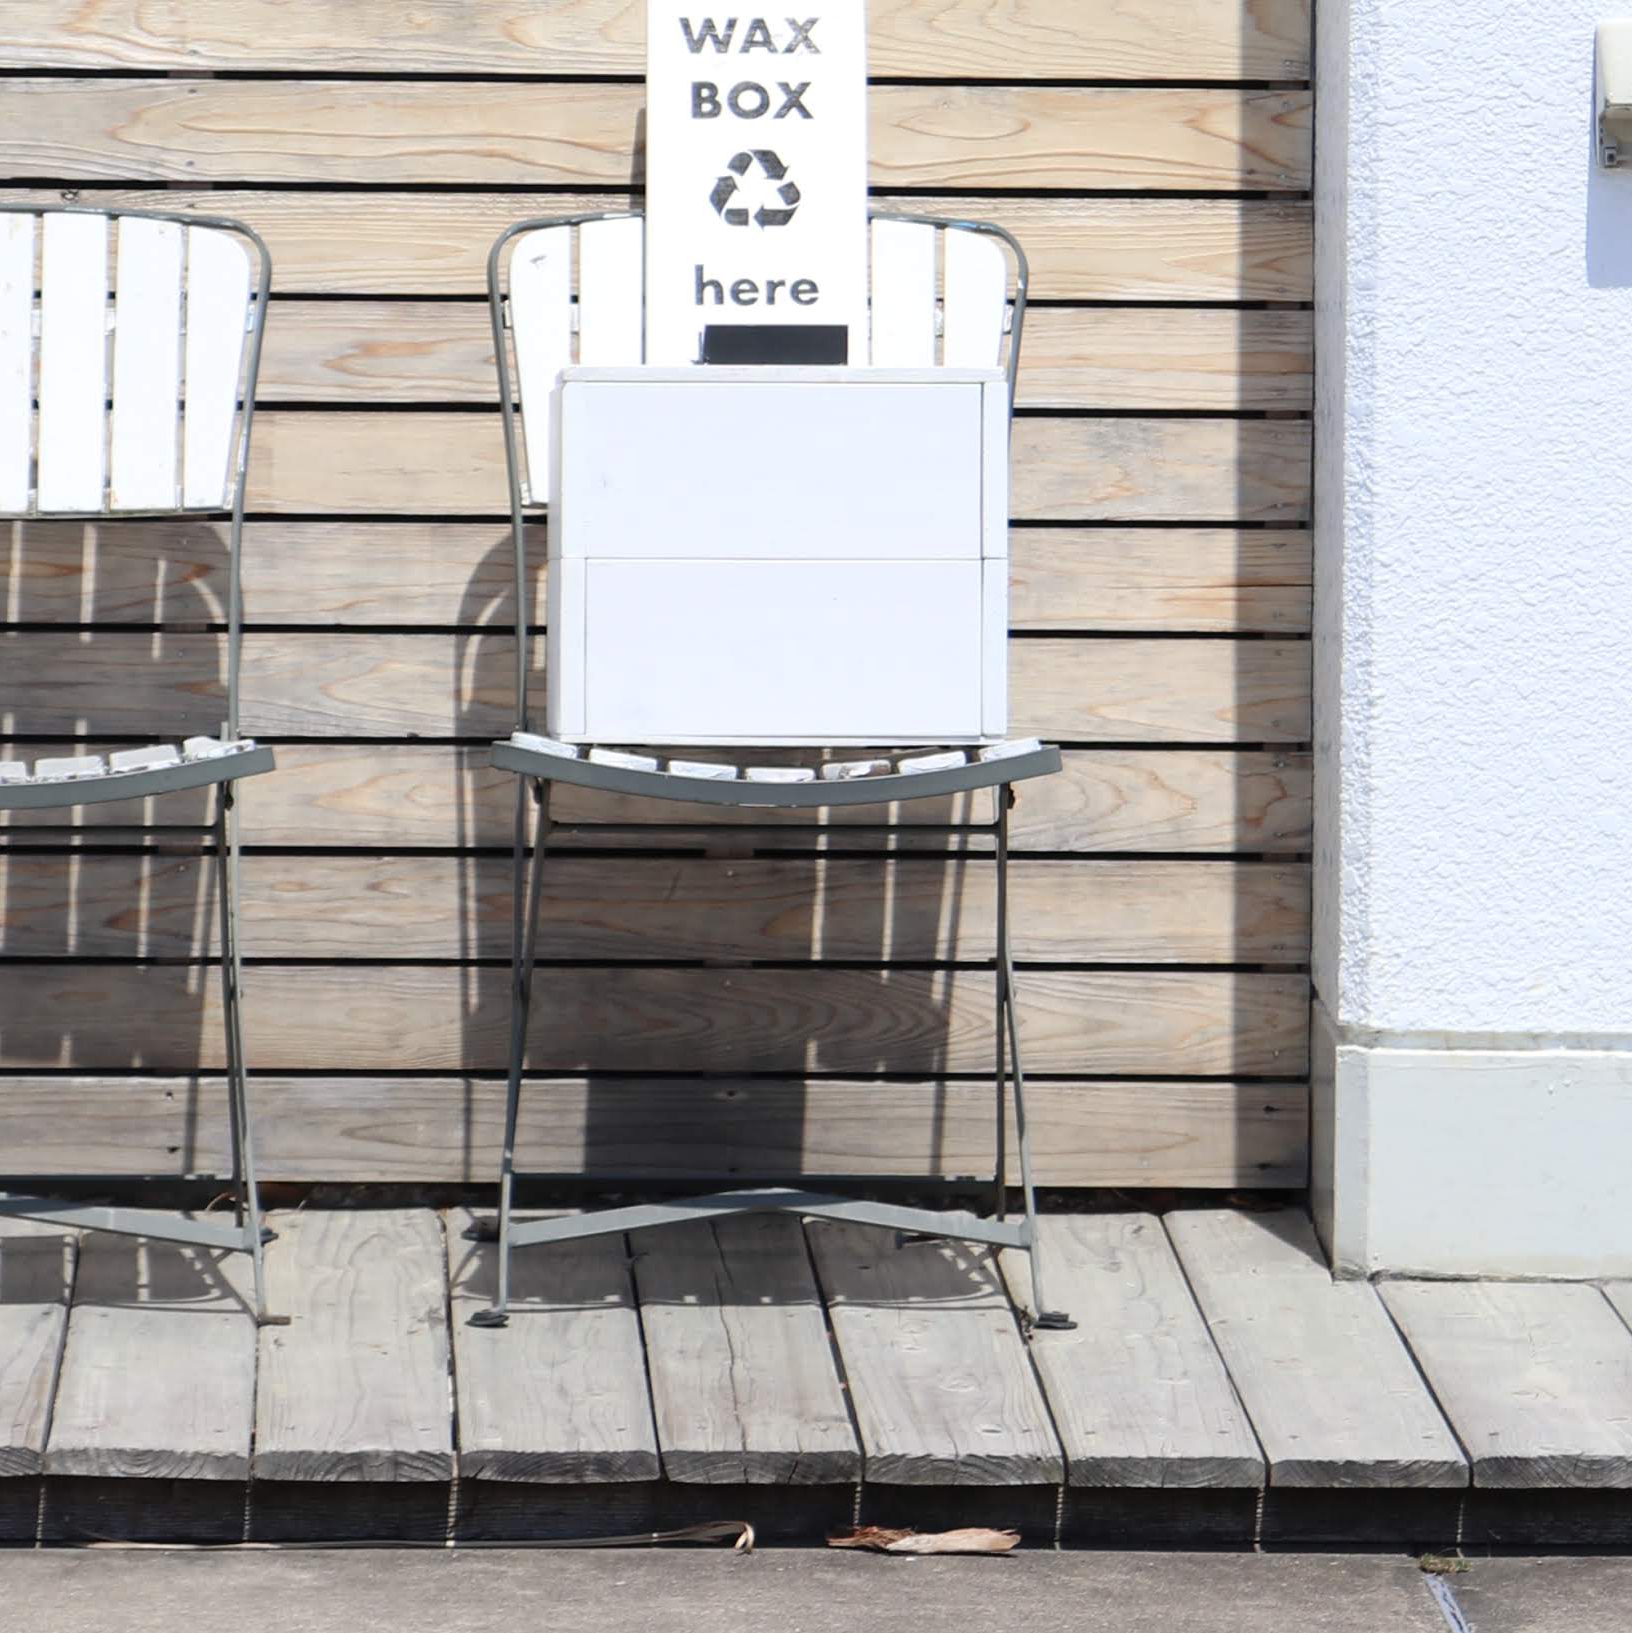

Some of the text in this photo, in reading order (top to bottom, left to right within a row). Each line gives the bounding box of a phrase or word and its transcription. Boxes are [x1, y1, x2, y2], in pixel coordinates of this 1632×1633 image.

[679, 17, 821, 54] WAX
[690, 81, 814, 119] BOX
[694, 264, 820, 306] here
